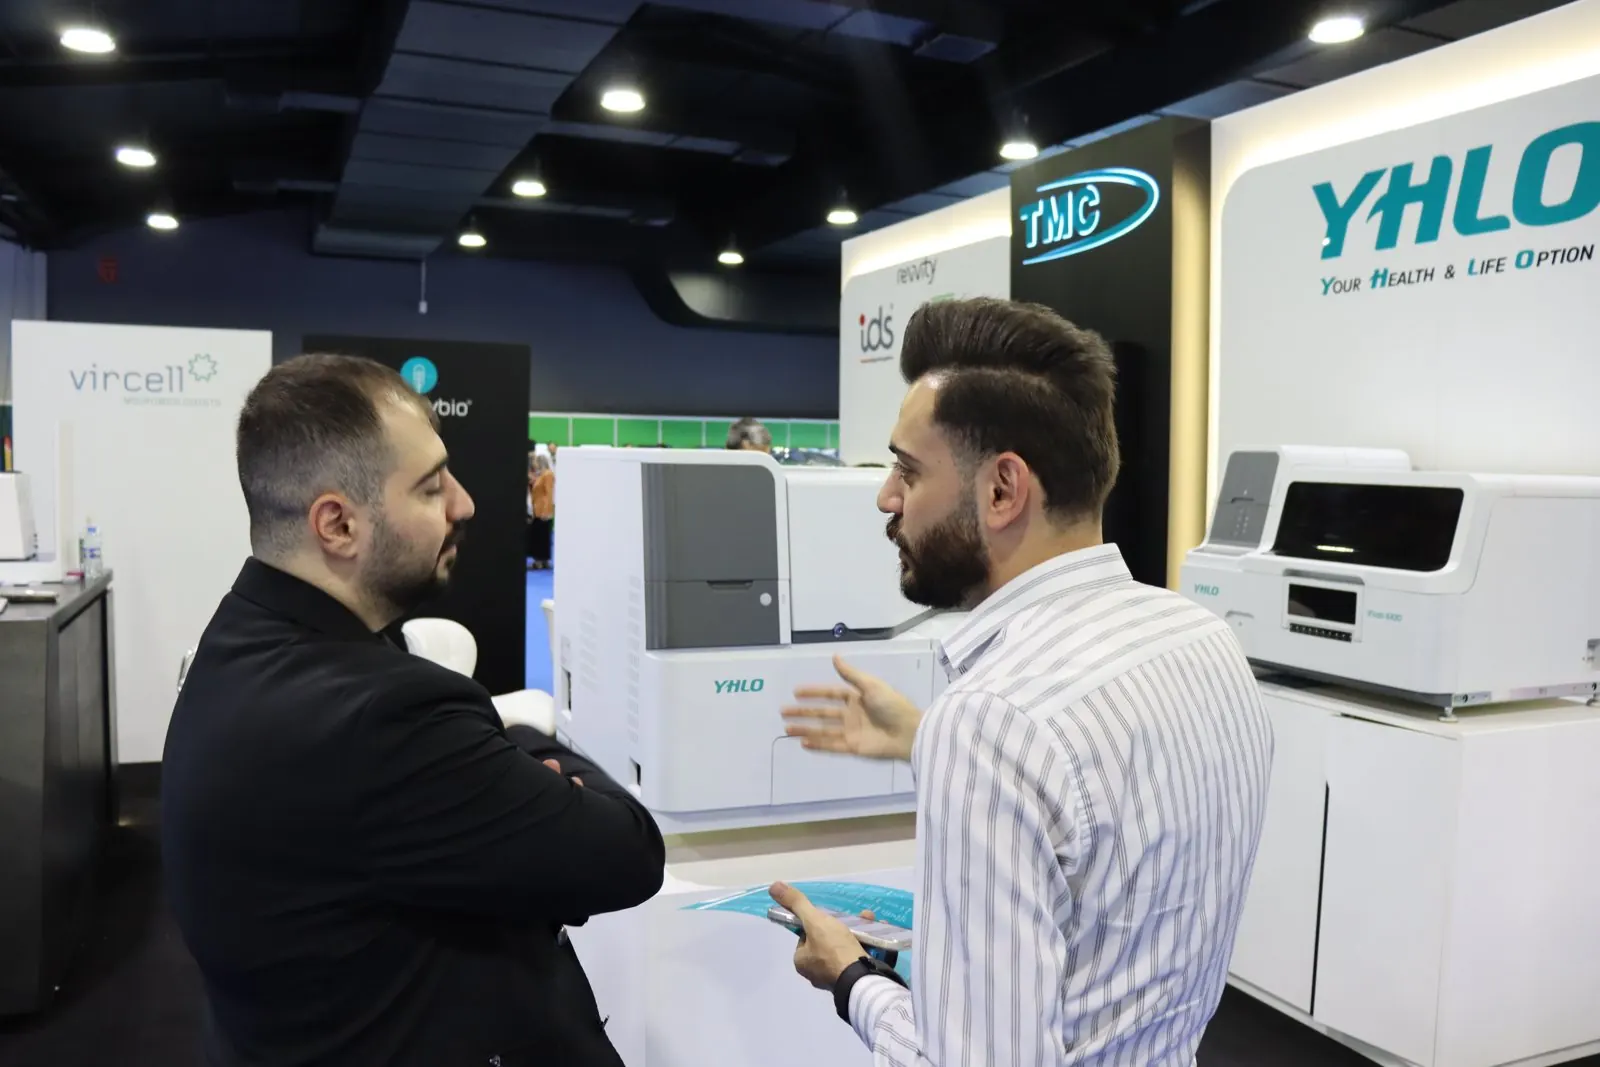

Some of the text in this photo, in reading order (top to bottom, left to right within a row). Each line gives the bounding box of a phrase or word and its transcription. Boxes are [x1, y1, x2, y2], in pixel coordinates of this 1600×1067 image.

[1311, 121, 1600, 260] YHLO
[1020, 184, 1100, 248] TMC
[1321, 244, 1595, 296] YOUR HEALTH & LIFE OPTION
[859, 305, 894, 352] ids
[69, 363, 184, 393] vircell
[714, 679, 764, 694] YHLO
